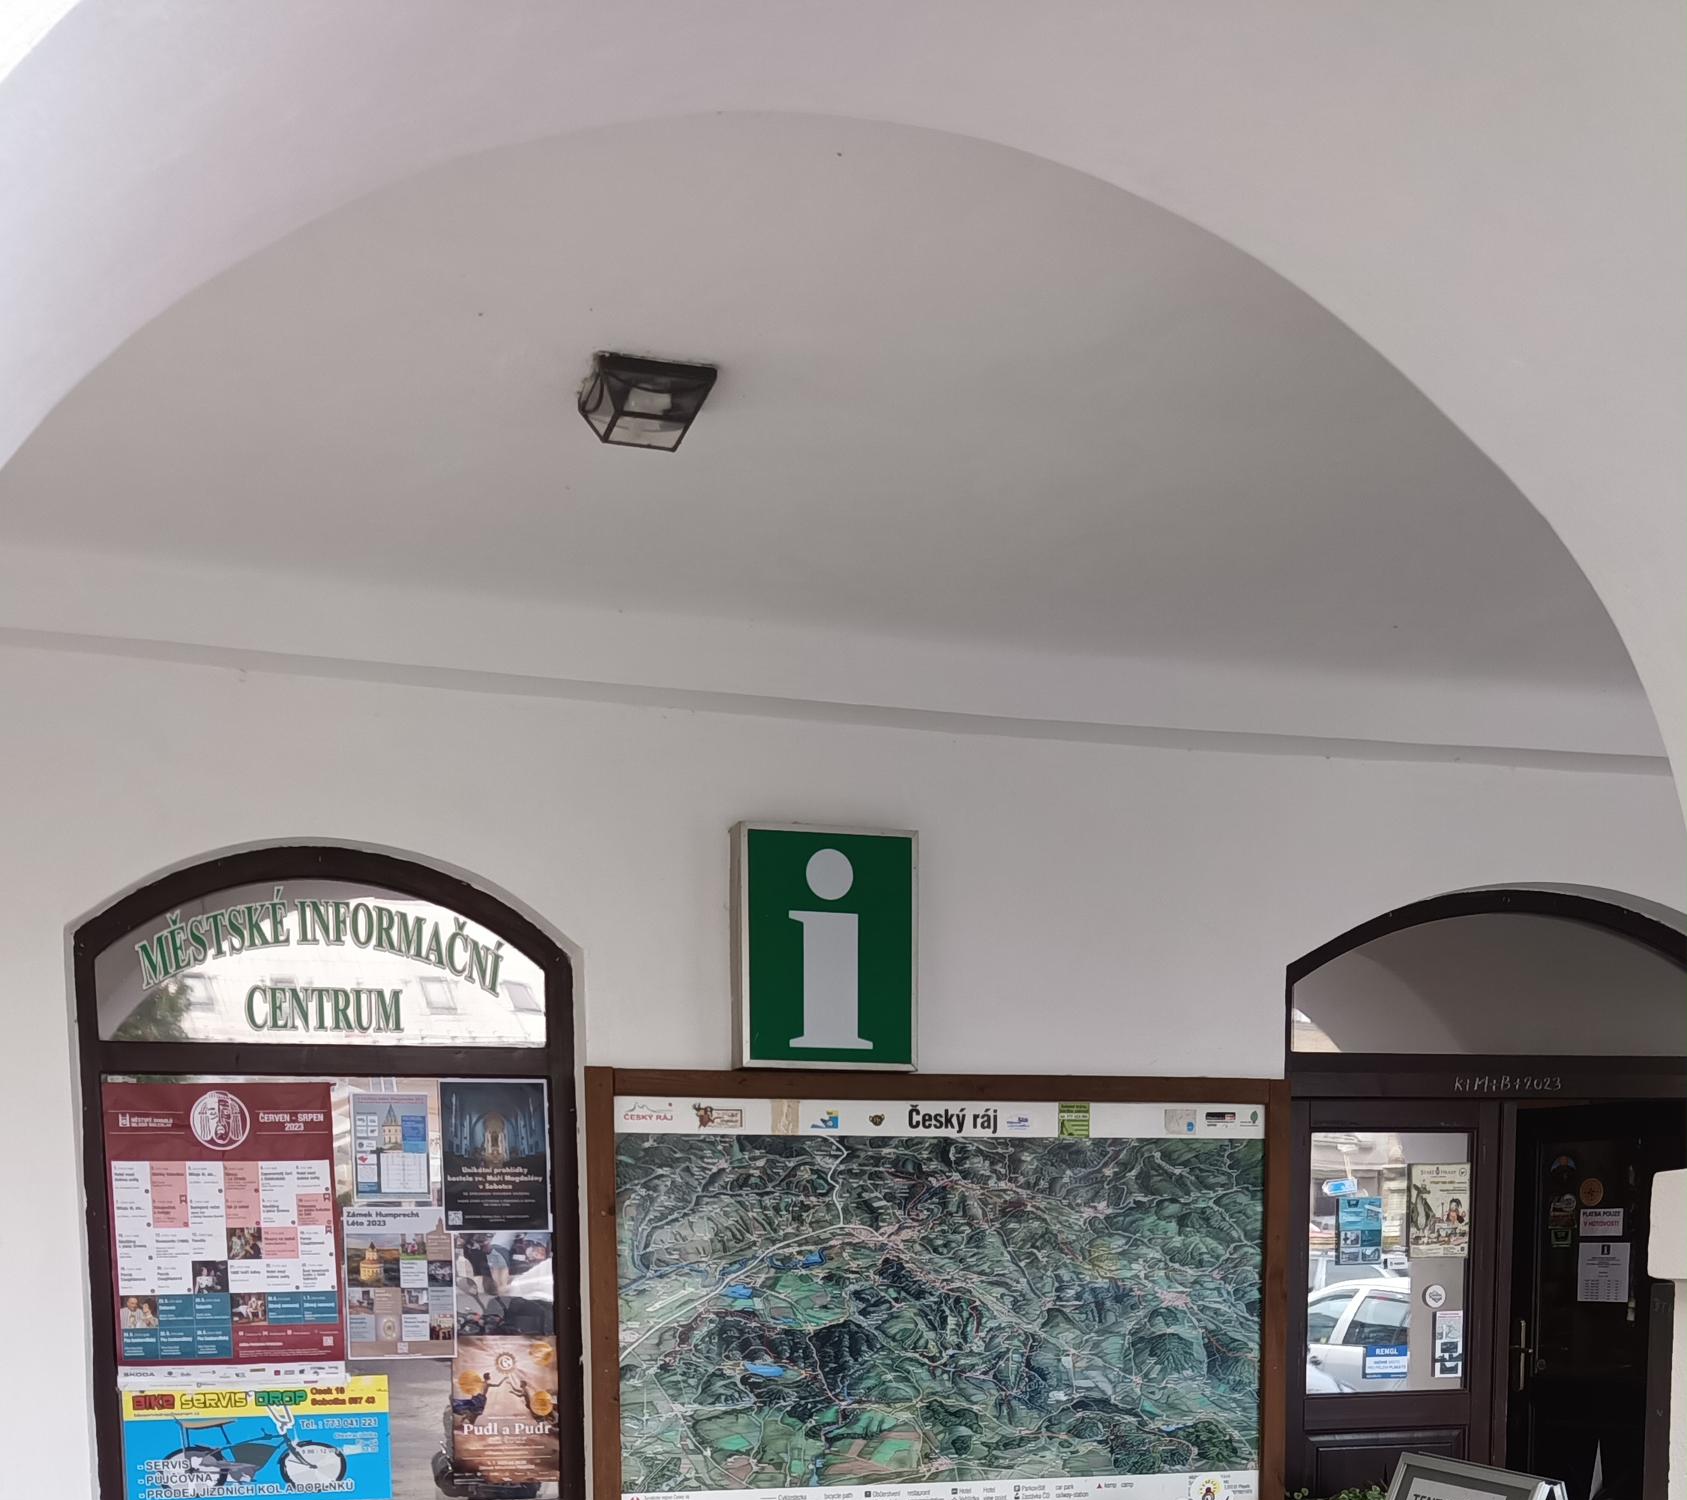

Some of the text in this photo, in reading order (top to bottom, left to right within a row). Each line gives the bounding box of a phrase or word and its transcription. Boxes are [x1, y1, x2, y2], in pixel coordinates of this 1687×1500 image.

[135, 886, 506, 998] MĚSTSKÉ INFORMAČNÍ
[244, 984, 404, 1033] CENTRUM
[259, 1112, 290, 1122] ČERVEN
[297, 1113, 324, 1121] SRPEN
[908, 1104, 966, 1134] Český
[972, 1105, 999, 1135] ráj
[376, 1211, 420, 1219] Humprecht
[463, 1421, 552, 1435] Pudl a Pudr
[146, 1459, 189, 1470] SERVIS
[146, 1472, 212, 1485] PŮJČOVNA
[147, 1488, 196, 1498] PRODEJ
[258, 1484, 283, 1494] KOL
[286, 1483, 294, 1493] A
